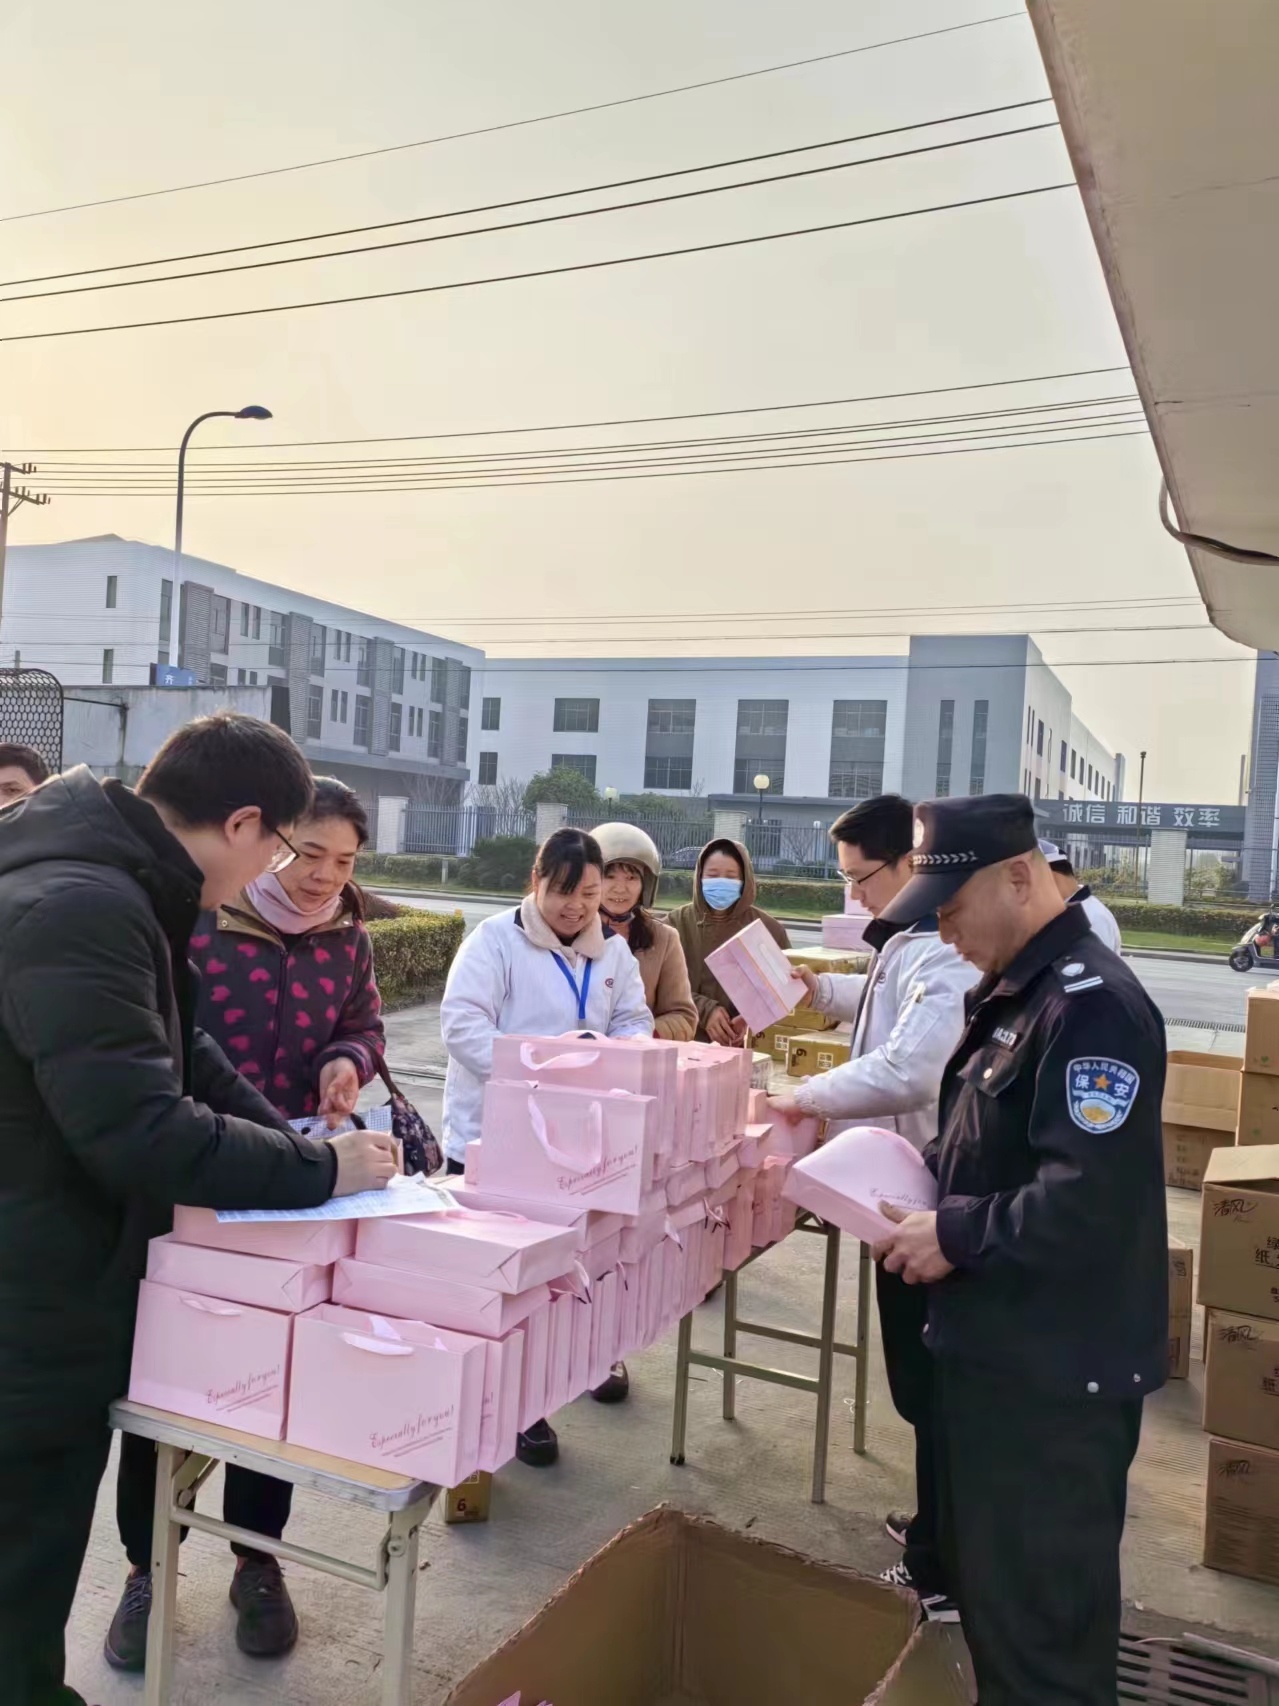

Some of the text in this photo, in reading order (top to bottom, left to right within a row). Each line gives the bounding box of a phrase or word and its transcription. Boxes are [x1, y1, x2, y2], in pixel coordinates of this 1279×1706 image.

[1063, 803, 1221, 828] 诚信 和谐 效率
[1073, 1061, 1136, 1085] 中华人民共和国
